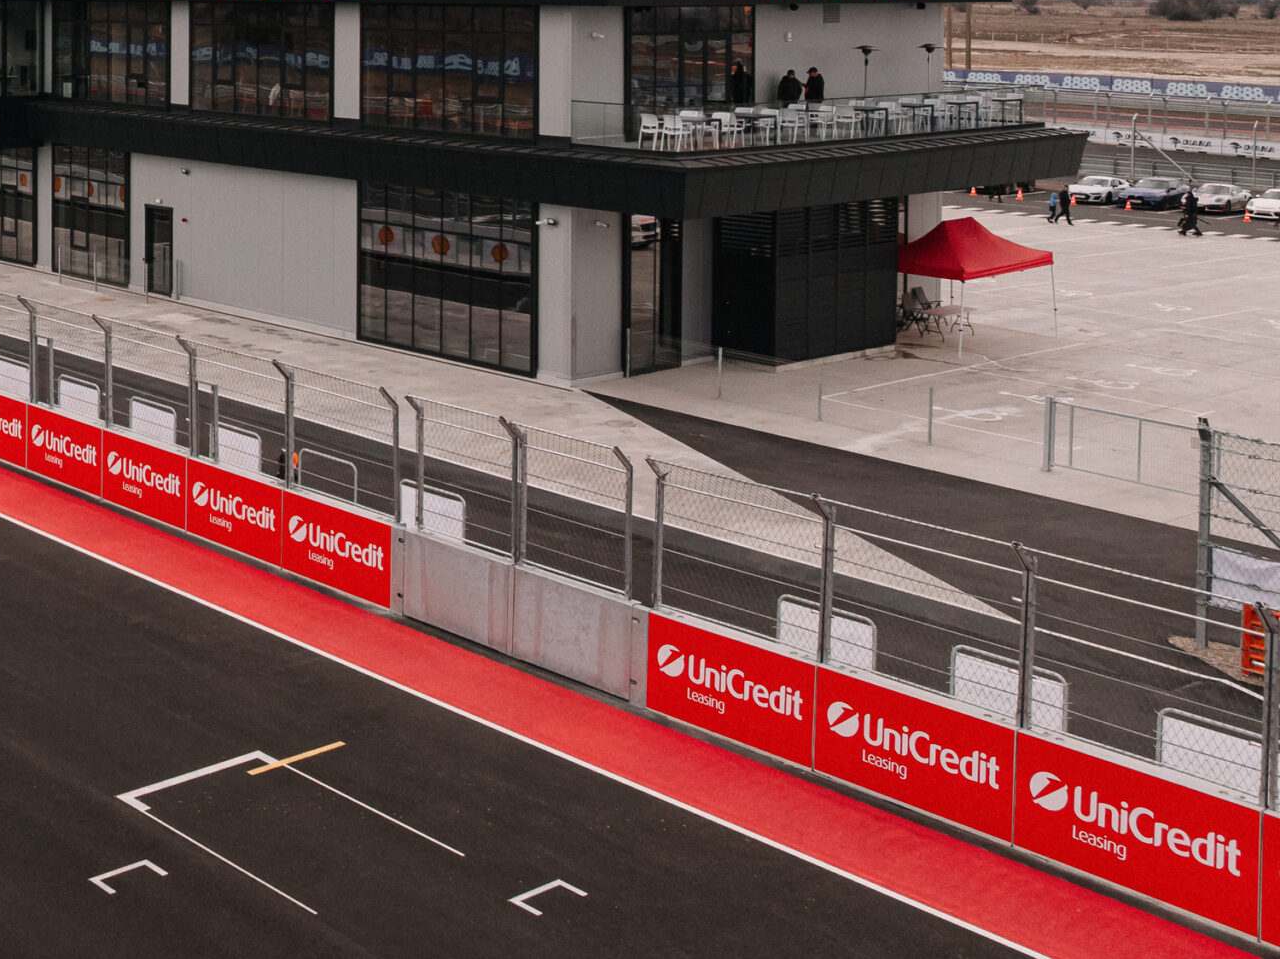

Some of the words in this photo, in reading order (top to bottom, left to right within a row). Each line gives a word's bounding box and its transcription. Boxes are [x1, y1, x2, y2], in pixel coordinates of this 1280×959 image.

[45, 434, 97, 466] UniCredit
[45, 452, 63, 468] Leasing
[123, 459, 180, 497] UniCredit
[123, 481, 142, 498] Leasing
[210, 488, 275, 532] UniCredit
[210, 513, 232, 532] Leasing
[308, 549, 334, 570] Leasing
[309, 523, 384, 571] UniCredit
[687, 687, 725, 714] Leasing
[688, 658, 803, 721] UniCredit
[862, 749, 907, 780] Leasing
[863, 713, 1000, 790] UniCredit
[1072, 824, 1127, 860] Leasing
[1073, 784, 1241, 877] UniCredit
